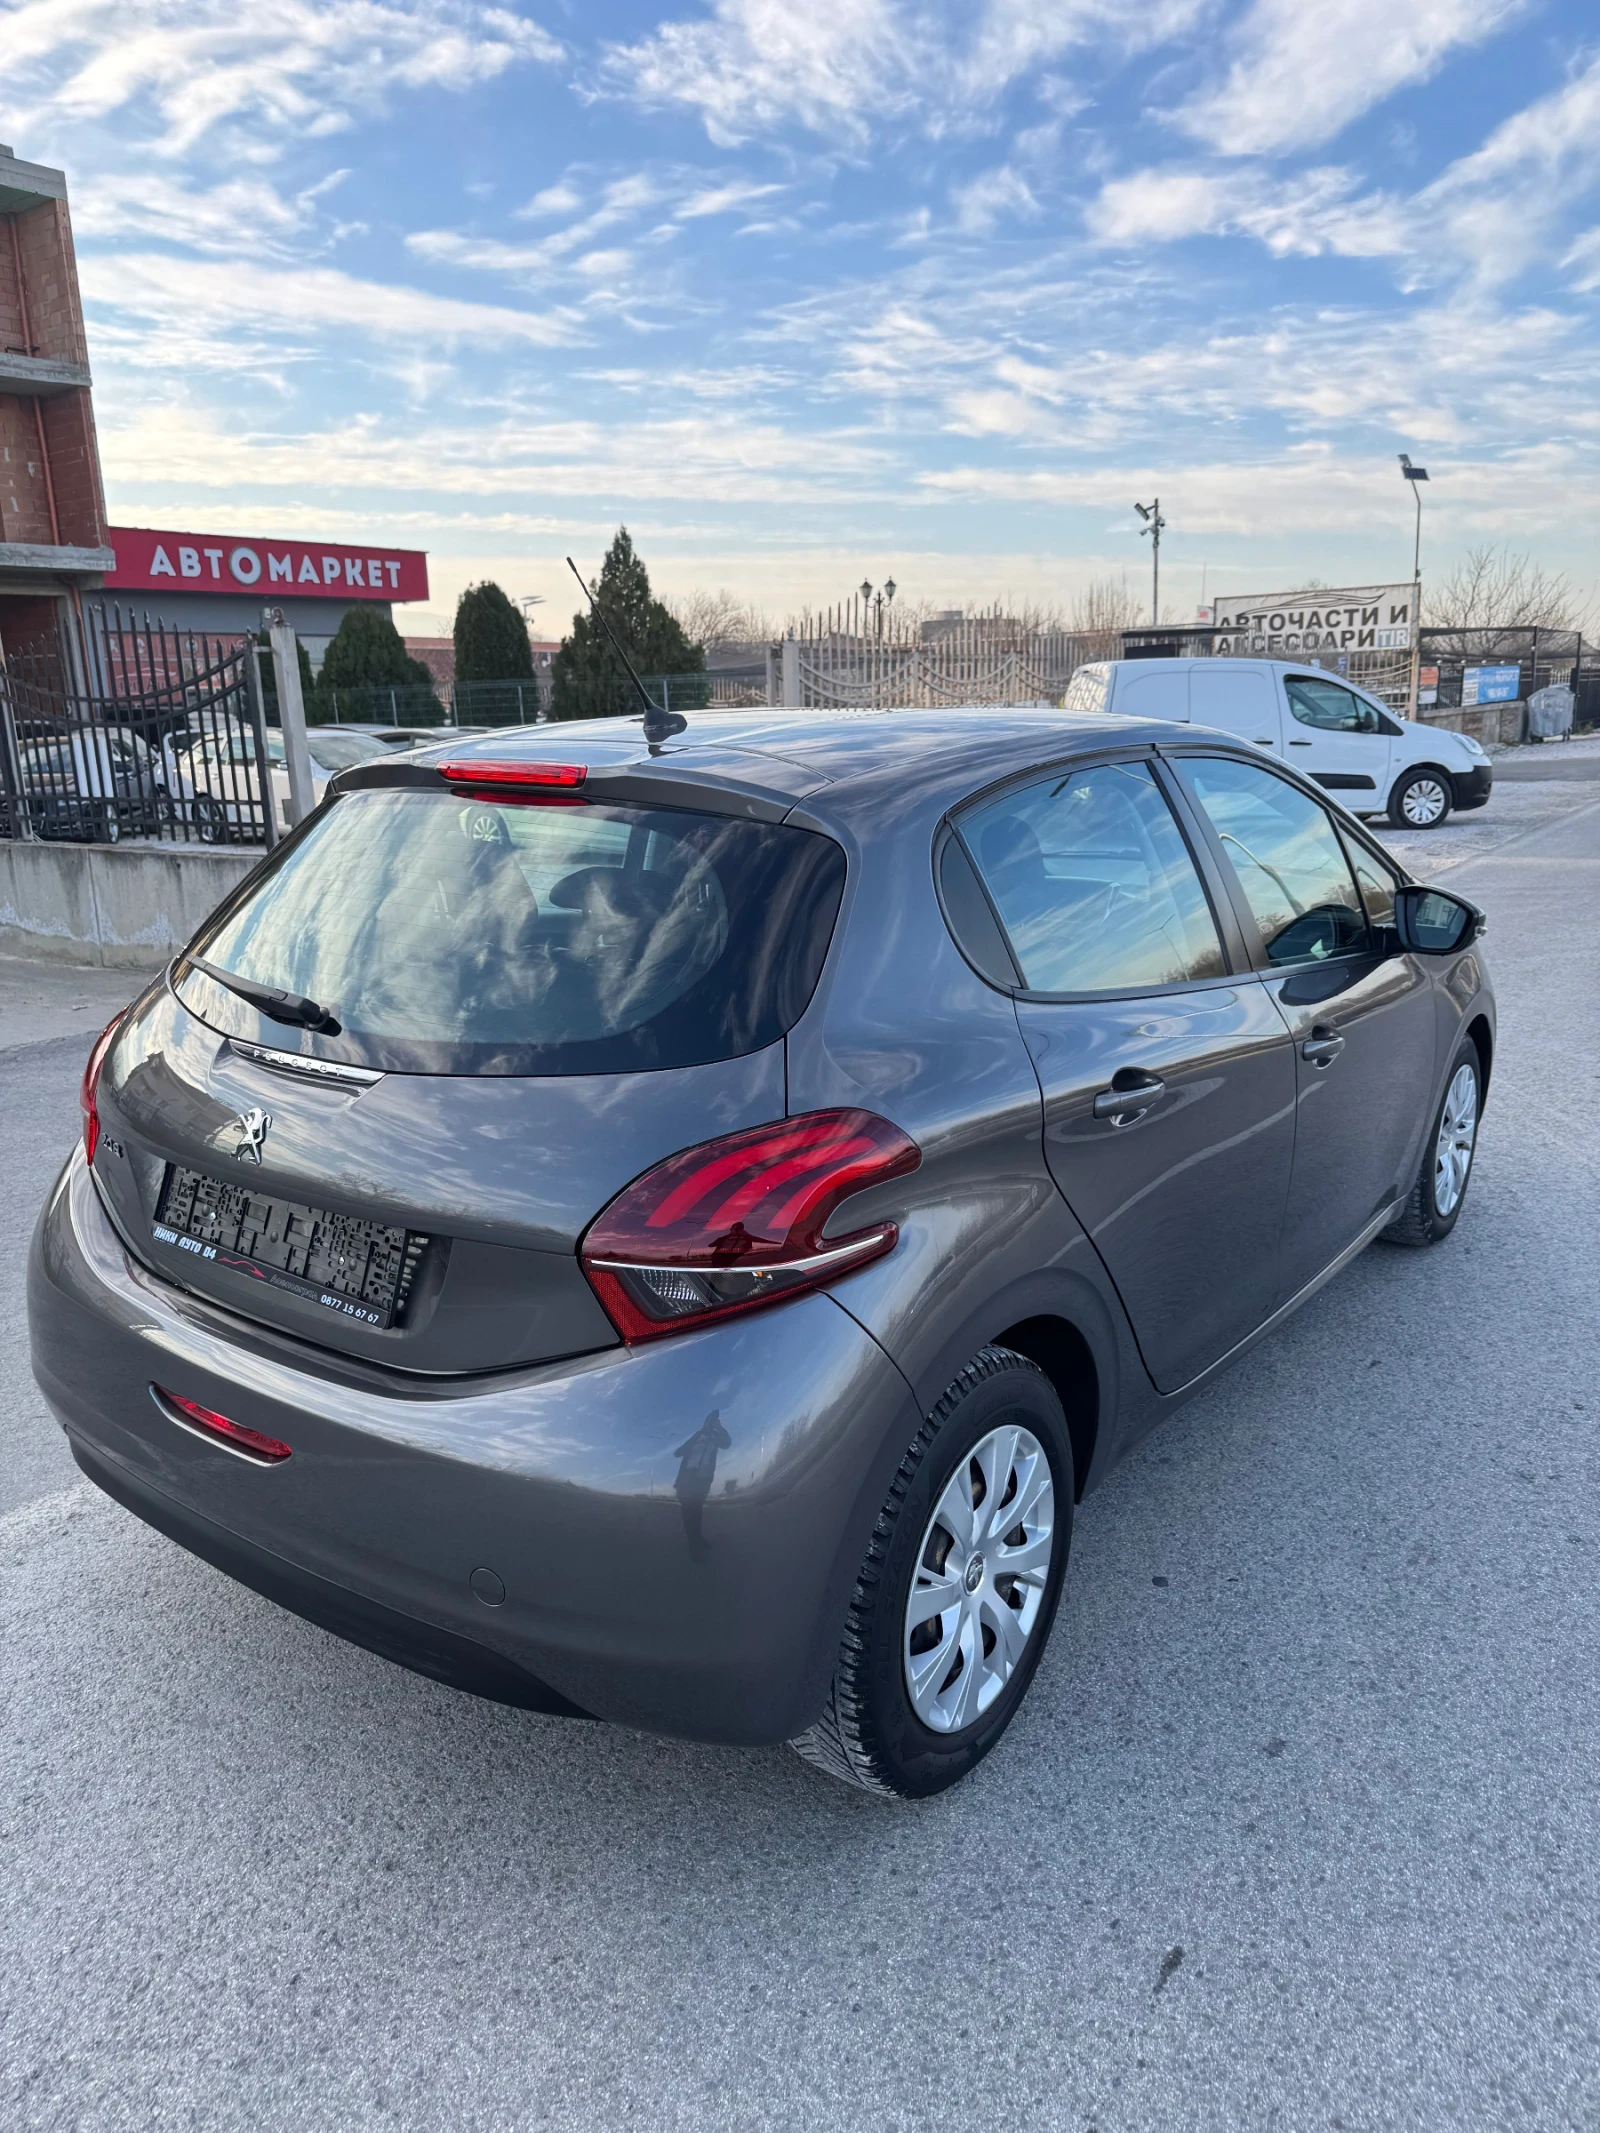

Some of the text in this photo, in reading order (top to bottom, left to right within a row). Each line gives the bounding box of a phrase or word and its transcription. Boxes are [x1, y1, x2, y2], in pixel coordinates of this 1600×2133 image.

[149, 544, 401, 589] АВТОМАРКЕТ
[1390, 604, 1408, 624] И
[1379, 629, 1407, 647] TIR
[253, 1049, 342, 1077] PEUGEOT
[153, 1226, 178, 1244] НИКИ
[320, 1294, 379, 1324] 0877 15 67 67
